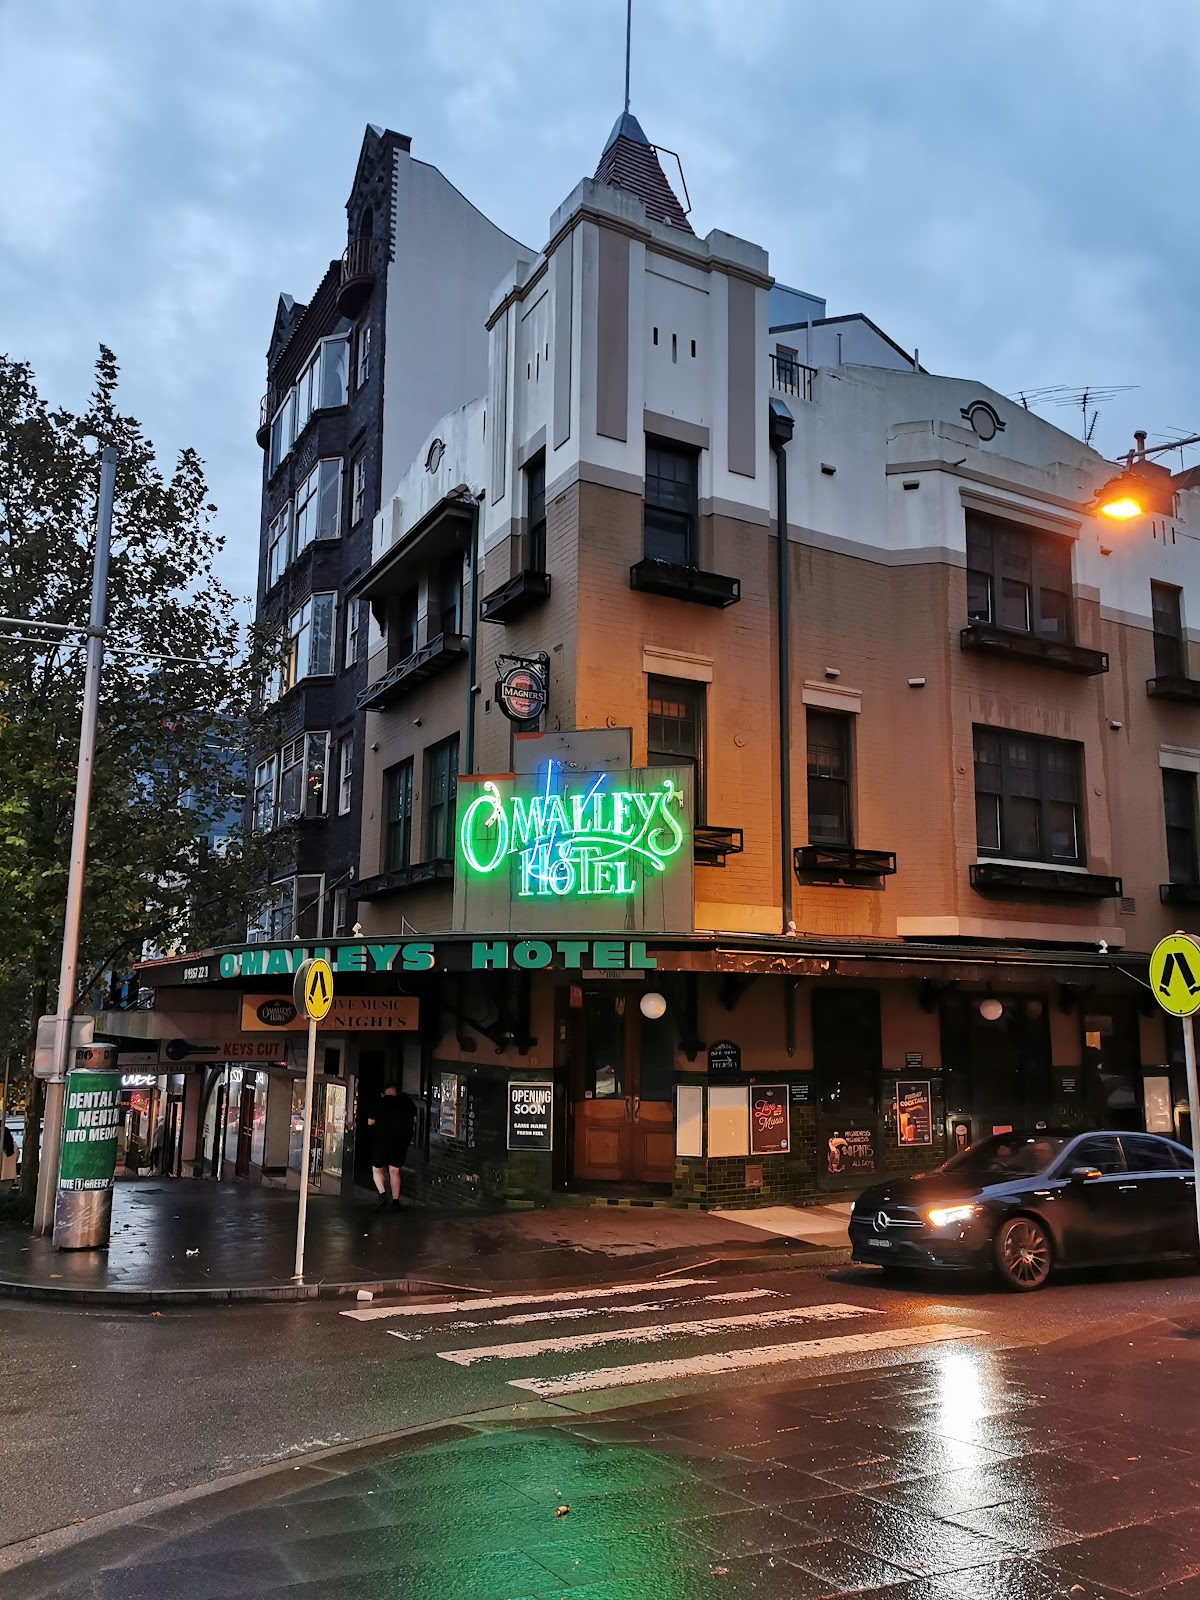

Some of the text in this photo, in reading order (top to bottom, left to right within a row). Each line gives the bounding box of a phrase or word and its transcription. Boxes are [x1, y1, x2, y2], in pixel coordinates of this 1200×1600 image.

[504, 686, 544, 701] MAGNERS
[518, 840, 637, 897] HOTEL
[472, 940, 658, 969] HOTEL
[333, 999, 399, 1010] IVE MUSIC
[334, 1016, 407, 1027] NIGHTS
[223, 1042, 254, 1056] KEYS
[256, 1042, 281, 1056] CUT
[69, 1091, 114, 1109] DENTAL
[511, 1089, 552, 1104] OPENING
[899, 1096, 928, 1108] COCKTAILS
[904, 1090, 923, 1101] FRIDAY
[513, 1103, 546, 1115] SOON
[754, 1100, 776, 1117] Live
[758, 1116, 784, 1132] Music
[65, 1129, 87, 1143] INTO
[60, 1179, 75, 1190] VOTE
[85, 1178, 110, 1189] GREENS
